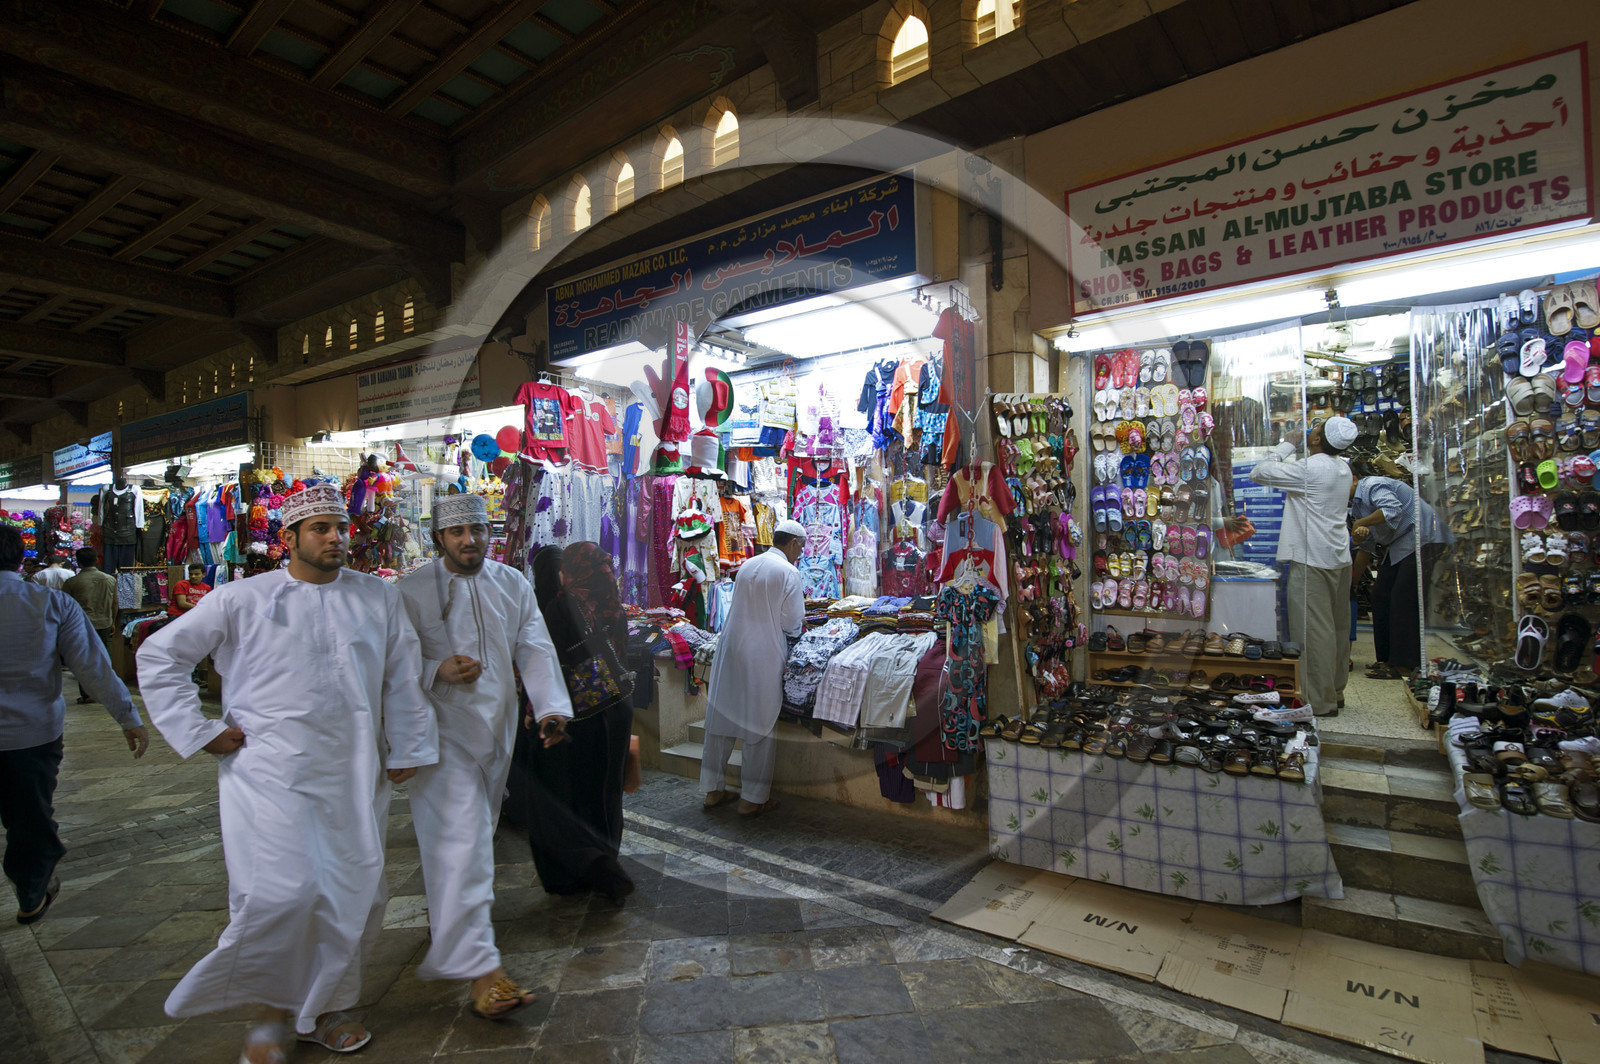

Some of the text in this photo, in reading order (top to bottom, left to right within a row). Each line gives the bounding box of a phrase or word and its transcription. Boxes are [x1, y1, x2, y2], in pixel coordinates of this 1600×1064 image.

[1094, 73, 1558, 214] مخزن حسن المجتبى
[1448, 96, 1569, 158] أحذية
[821, 196, 853, 217] ابناء
[858, 177, 899, 204] شركة
[1100, 150, 1538, 268] HASSAN AL-MUJTABA STORE
[780, 211, 816, 229] محمد
[1079, 217, 1158, 248] جلدية
[1080, 267, 1150, 299] SHOES,
[1160, 251, 1222, 283] BAGS
[1236, 245, 1253, 266] &
[1268, 215, 1386, 260] LEATHER
[1398, 175, 1571, 233] PRODUCTS
[554, 204, 899, 328] الملابس الجاهزة
[555, 248, 689, 301] ABNA MOHAMMED MAZAR CO. LLC.
[584, 298, 705, 351] READYMADE
[710, 257, 852, 317] GARMENTS
[398, 364, 414, 379] TRADING
[414, 360, 436, 376] للتجارة
[436, 358, 457, 371] رمضان
